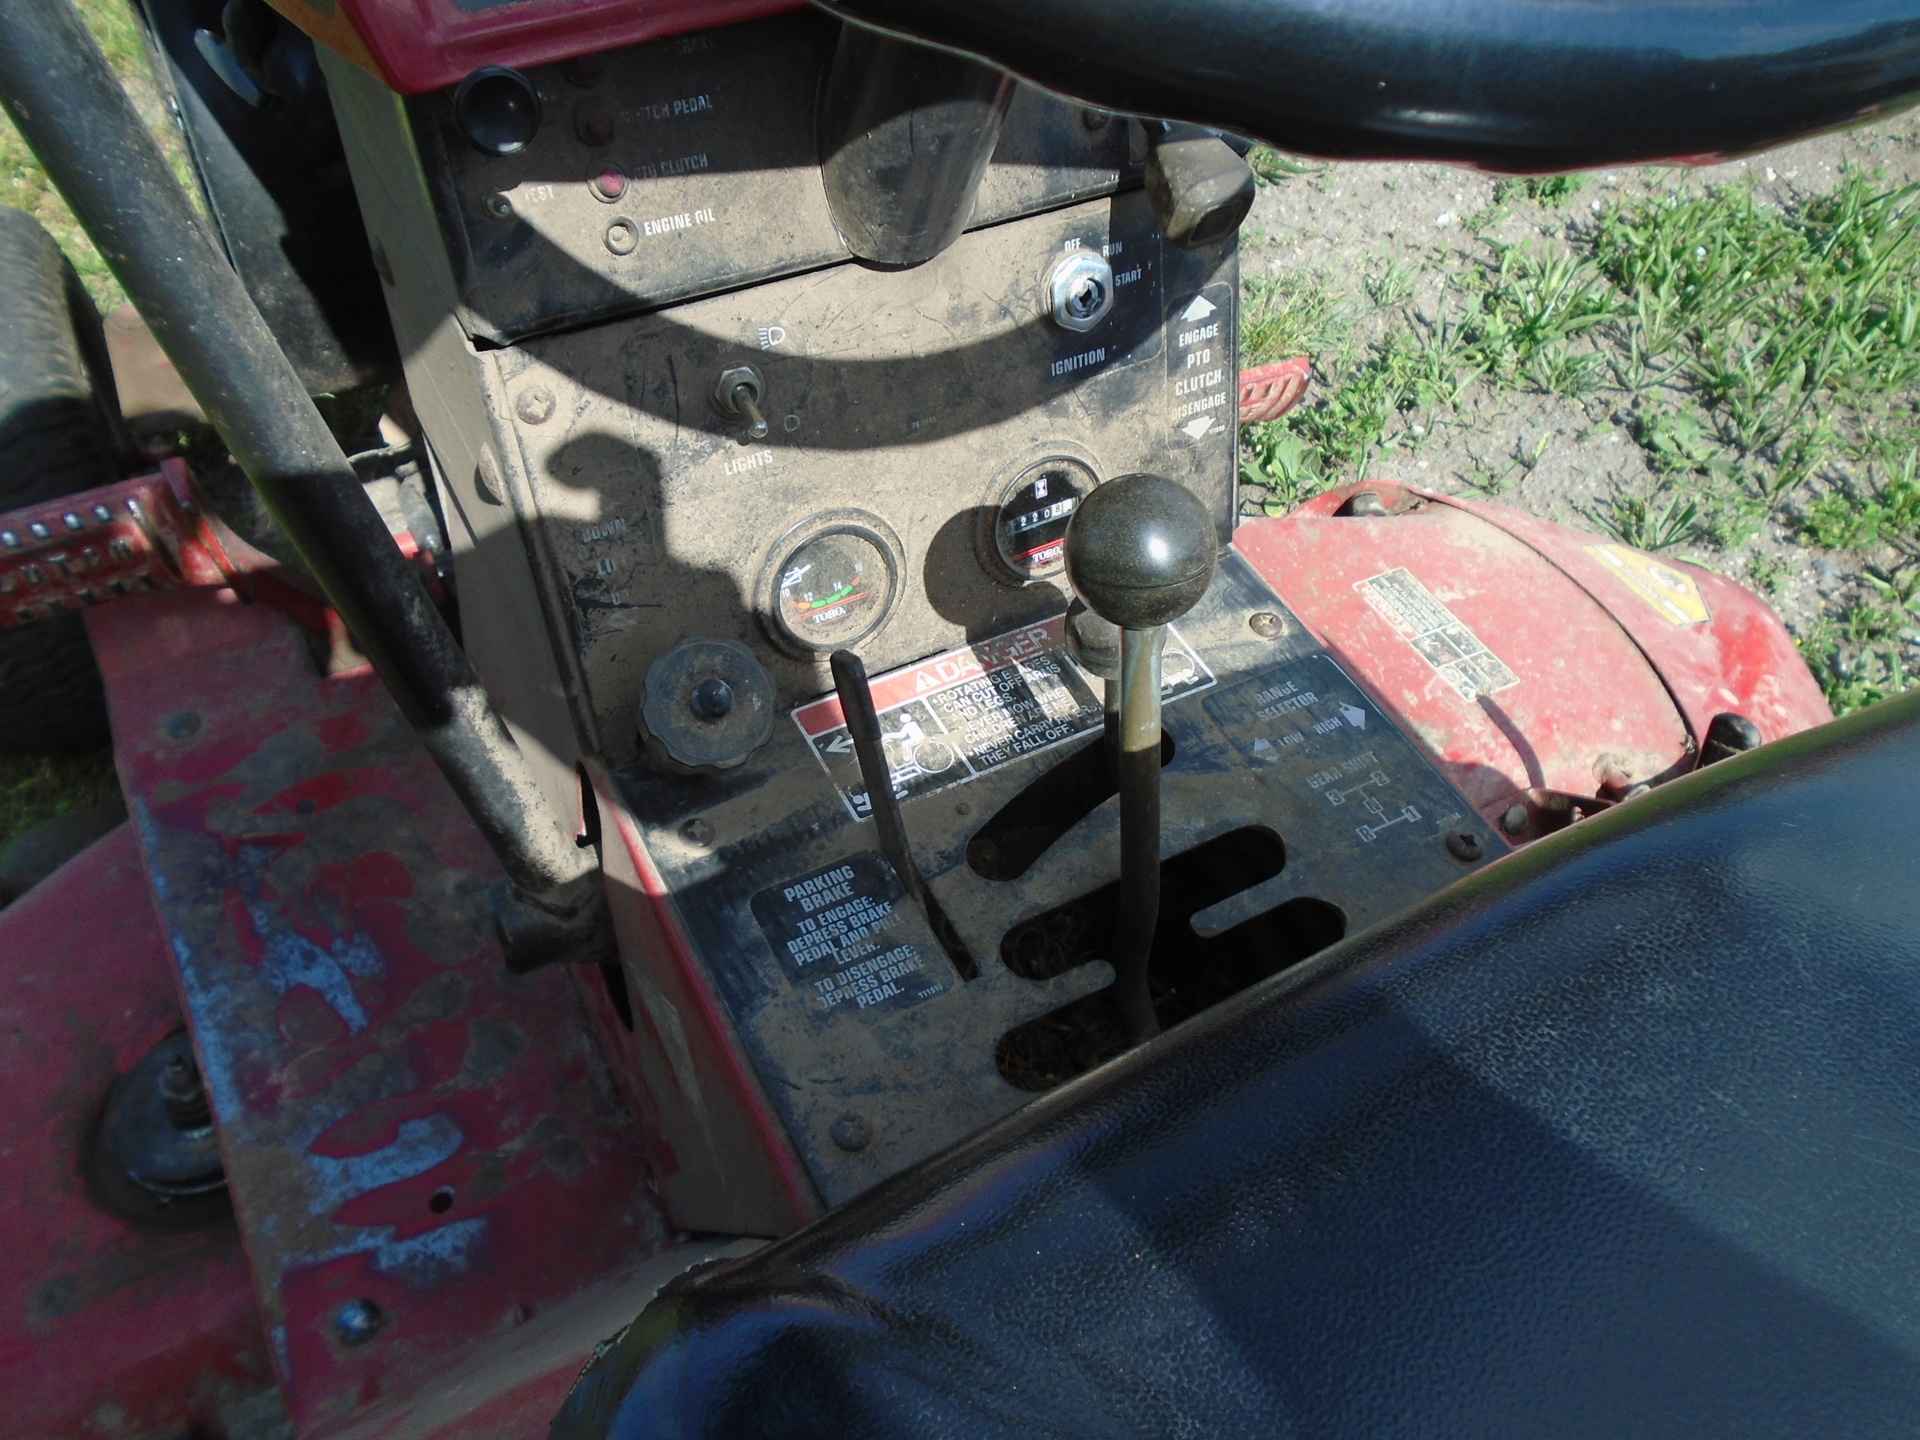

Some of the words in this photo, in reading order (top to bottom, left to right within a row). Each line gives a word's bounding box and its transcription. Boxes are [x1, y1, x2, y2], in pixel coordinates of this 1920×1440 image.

[673, 94, 713, 115] PEDAL
[660, 153, 709, 175] CLUTCH
[643, 211, 693, 236] ENGINE
[694, 207, 716, 226] OIL
[1064, 237, 1082, 252] OFF
[1102, 241, 1123, 257] RUN
[1115, 268, 1142, 287] START
[1179, 323, 1219, 348] ENGAGE
[1051, 347, 1106, 377] IGNITION
[1187, 348, 1211, 369] PTO
[1175, 368, 1222, 396] CLUTCH
[1171, 391, 1226, 421] DISENGAGE
[724, 449, 774, 476] LIGHTS
[781, 588, 791, 599] 10
[803, 592, 813, 602] 12
[833, 581, 843, 592] 14
[934, 627, 1048, 680] DANGER
[937, 674, 1001, 704] ROTATING
[943, 695, 973, 713] CAN
[972, 686, 999, 702] CUT
[999, 675, 1023, 692] OFF
[1025, 663, 1061, 683] ARMS
[1255, 680, 1298, 705] RANGE
[966, 711, 1003, 733] EVER
[1002, 700, 1034, 718] MOW
[1034, 684, 1067, 706] WHE
[1256, 691, 1319, 722] SELECTOR
[973, 734, 1015, 757] NEVER
[1014, 717, 1056, 741] CARRY
[1276, 731, 1305, 747] LOW
[1312, 716, 1342, 735] HIGH
[978, 745, 1013, 766] THEY
[1013, 735, 1047, 753] FALL
[1045, 724, 1075, 741] OFF.
[1306, 766, 1343, 789] GEAR
[783, 865, 855, 903] PARKING
[800, 882, 854, 912] BRAKE
[787, 920, 848, 954] DEPRESS
[849, 901, 893, 929] BRAKE
[796, 917, 816, 934] TO
[817, 895, 876, 925] ENGAGE:
[794, 940, 838, 966] PEDAL
[840, 926, 870, 947] AND
[833, 942, 881, 965] LEVER.
[814, 977, 835, 993] TO
[836, 944, 917, 987] DISENGAGE:
[816, 975, 879, 1009] DEPRESS
[879, 955, 925, 983] BRAKE
[856, 981, 905, 1009] PEDAL.
